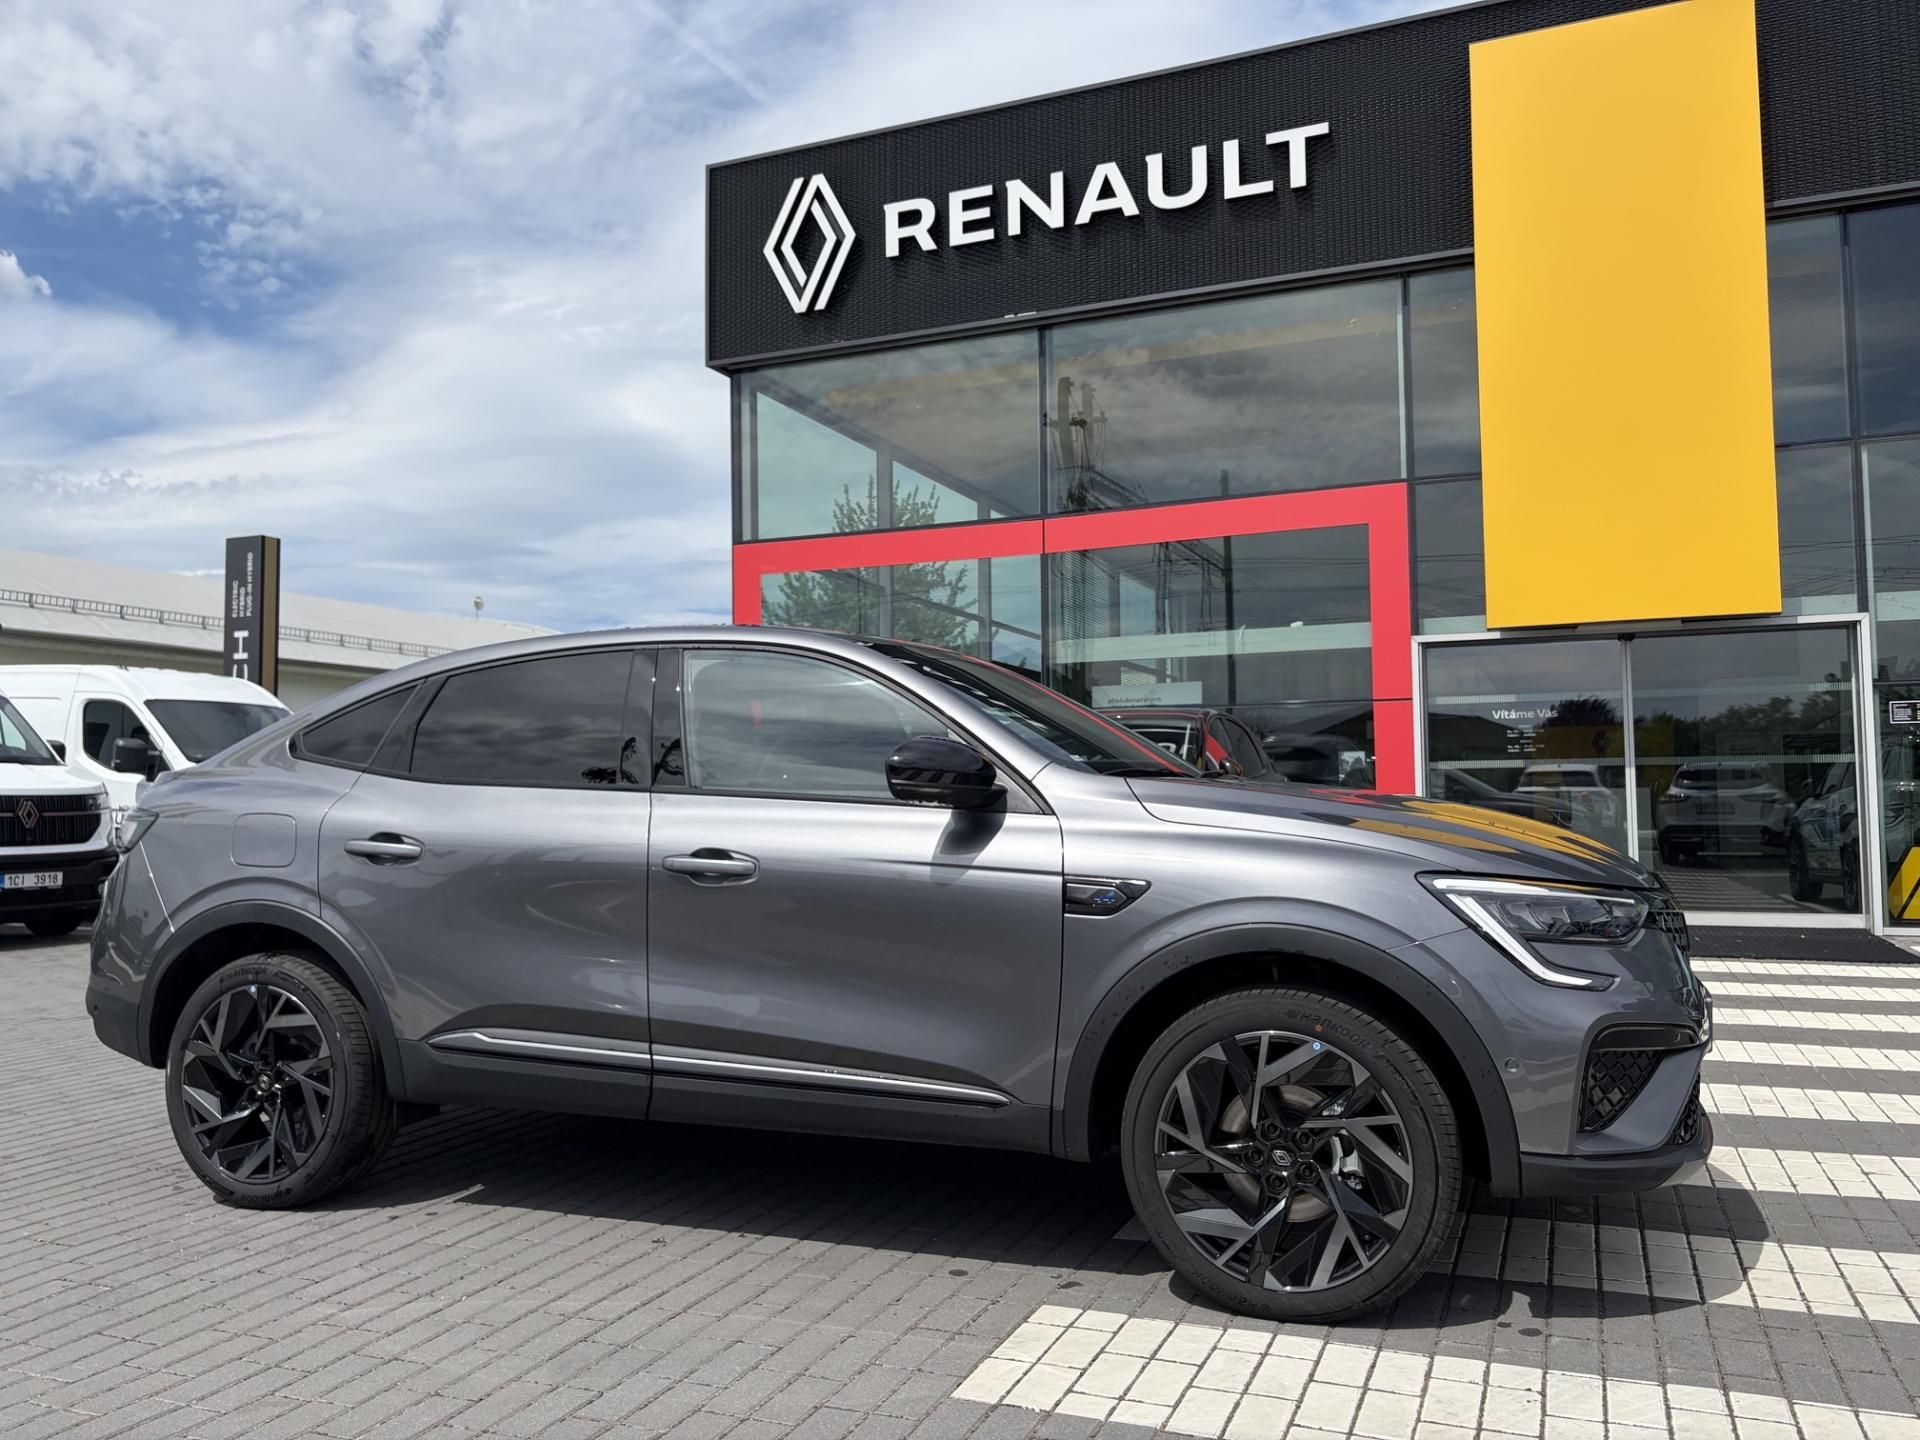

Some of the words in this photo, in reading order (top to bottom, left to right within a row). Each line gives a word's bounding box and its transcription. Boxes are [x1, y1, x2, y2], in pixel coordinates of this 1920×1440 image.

[883, 122, 1329, 258] RENAULT
[1492, 709, 1535, 719] Vítáme
[1537, 708, 1558, 718] Vás
[34, 873, 58, 885] 3918
